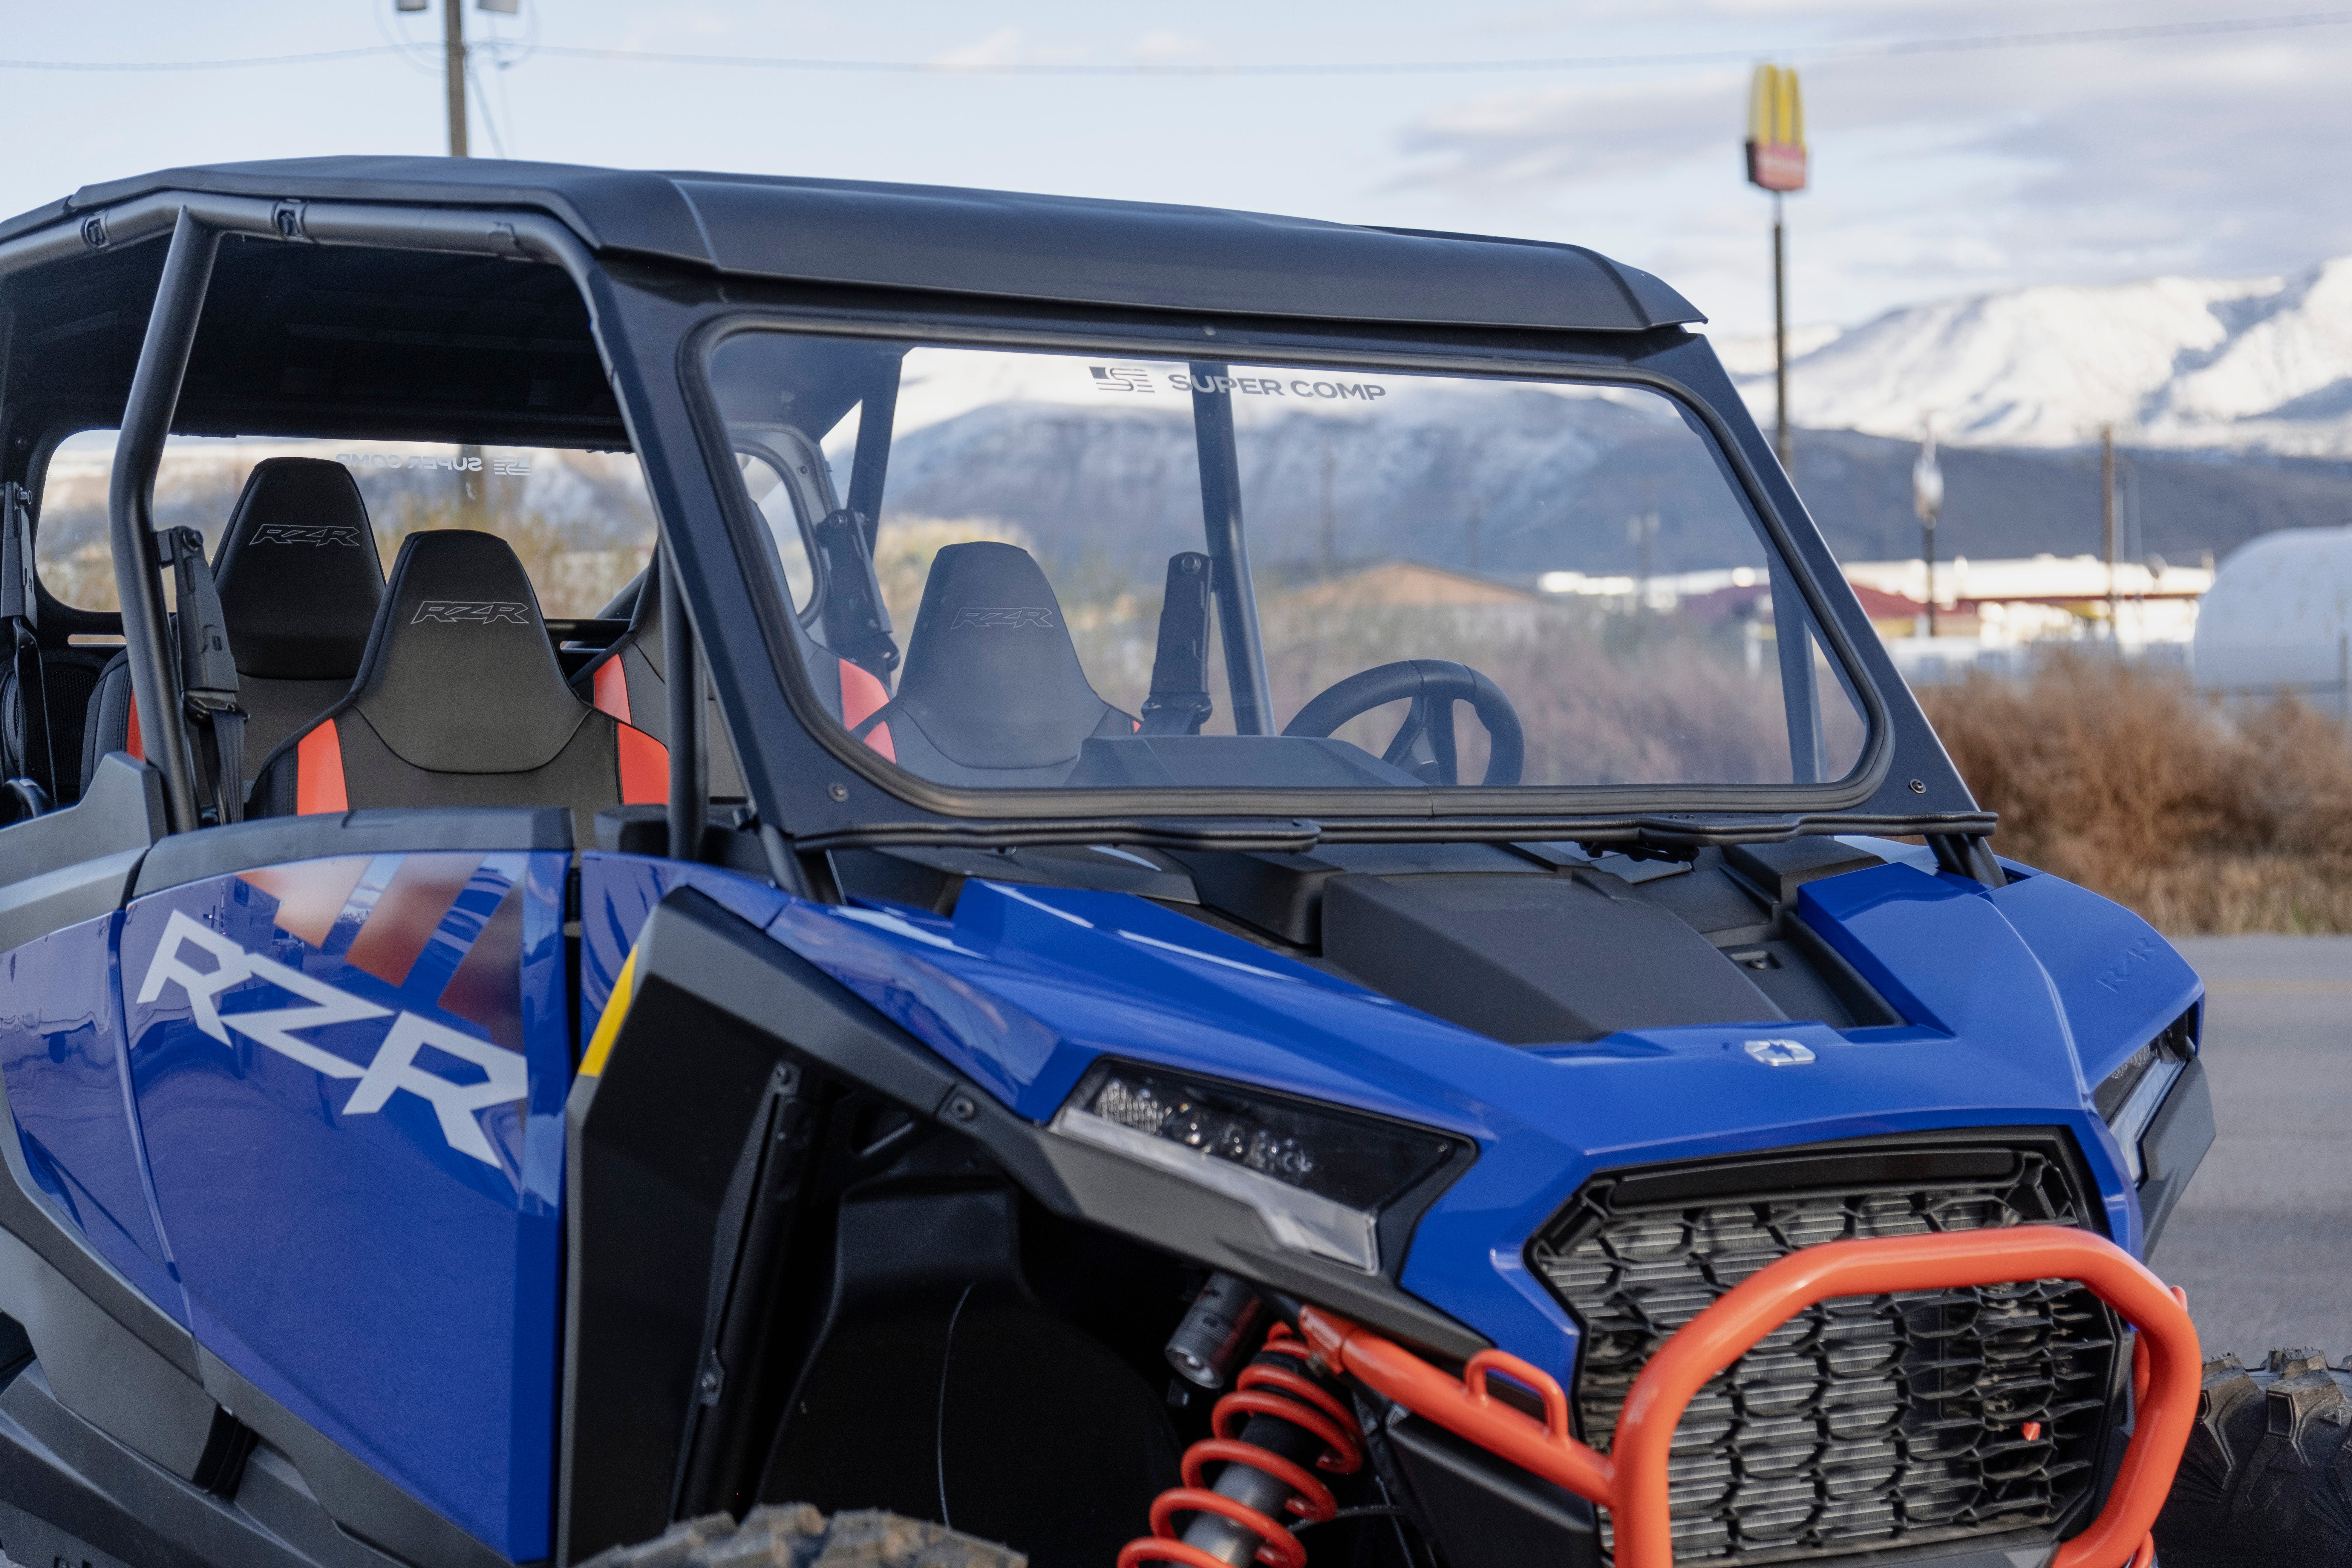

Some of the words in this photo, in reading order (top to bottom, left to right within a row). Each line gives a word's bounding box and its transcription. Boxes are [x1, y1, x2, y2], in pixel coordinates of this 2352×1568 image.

[1168, 374, 1285, 396] SUPER
[1290, 380, 1386, 400] COMP
[249, 524, 360, 547] RZR
[410, 600, 530, 624] RZR
[951, 606, 1055, 629] RZR
[136, 908, 528, 1169] RZR
